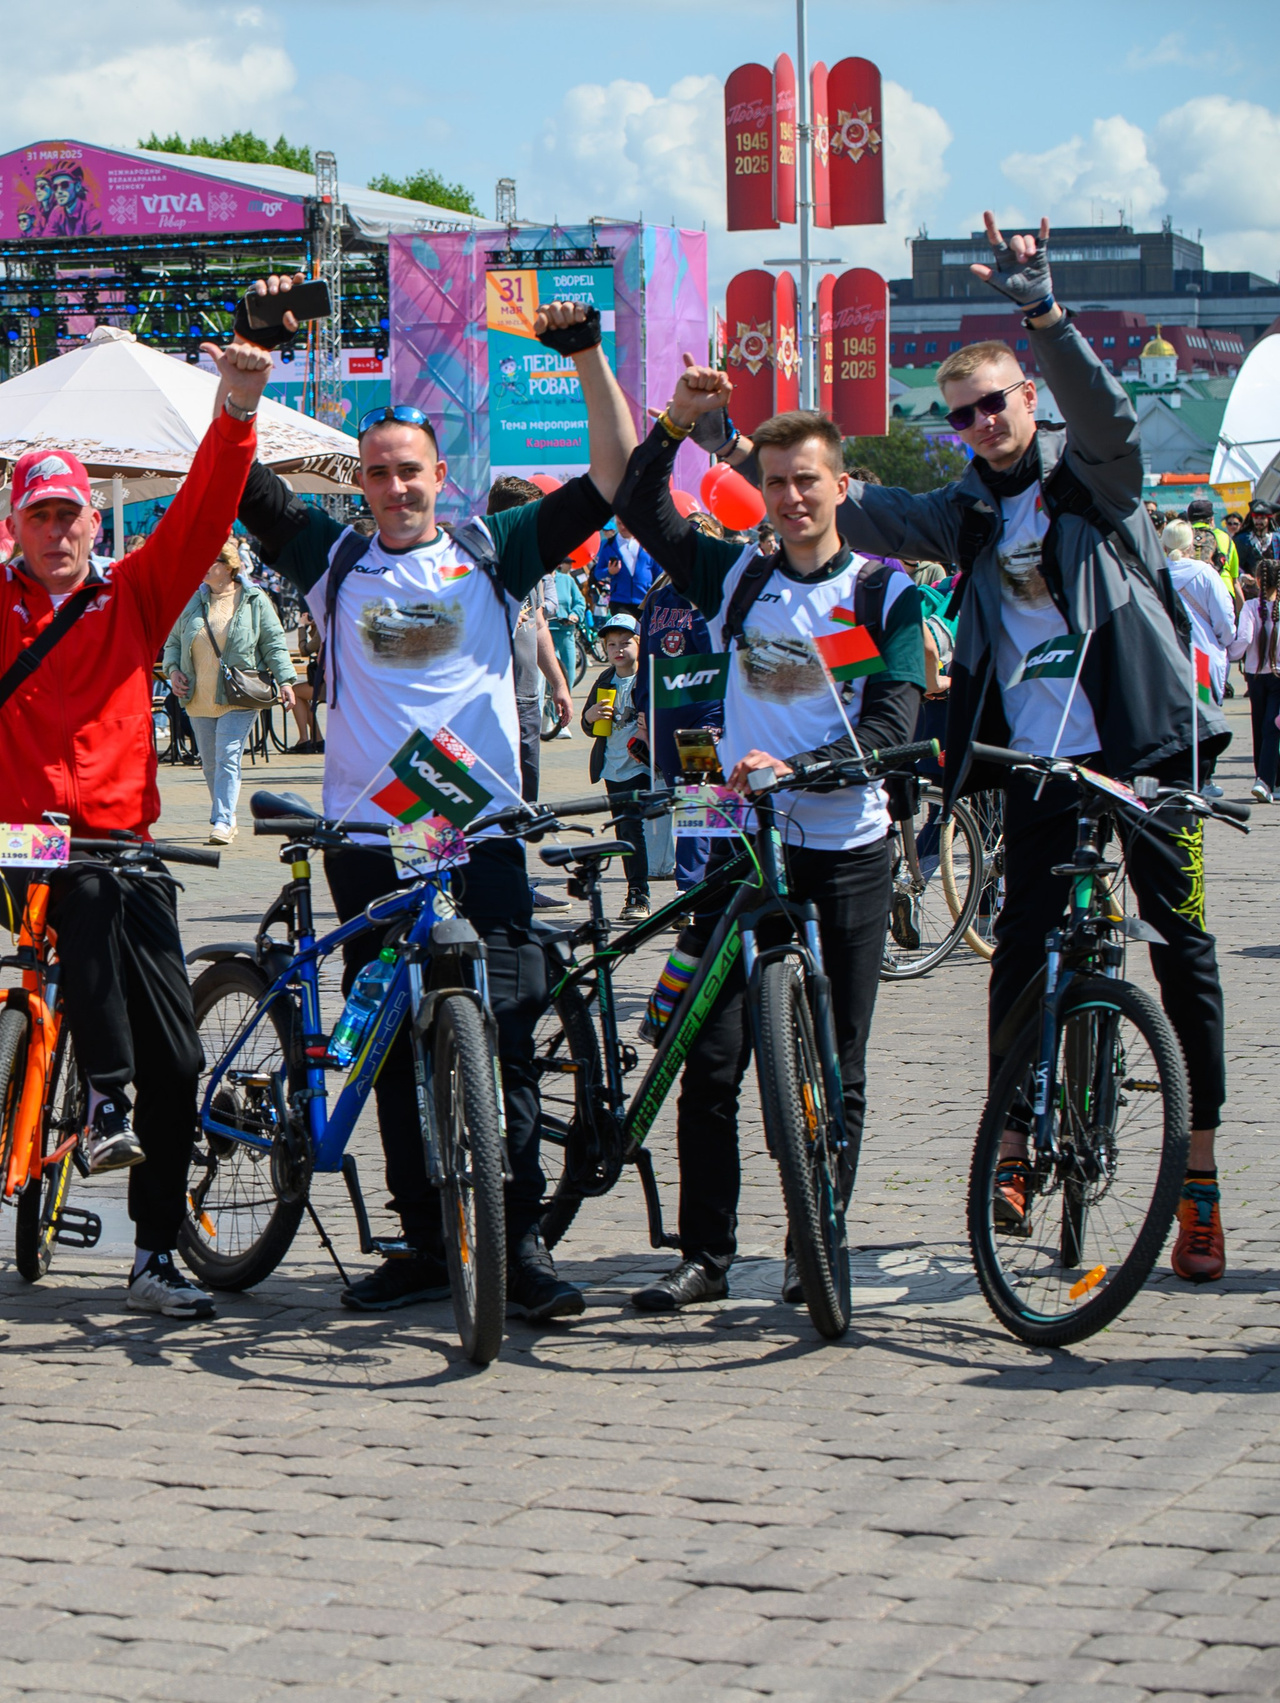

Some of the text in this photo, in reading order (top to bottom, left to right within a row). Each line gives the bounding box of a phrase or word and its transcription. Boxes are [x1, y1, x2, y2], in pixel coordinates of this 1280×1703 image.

[736, 132, 768, 152] 1945
[40, 151, 58, 159] МАЯ
[60, 150, 83, 159] 2025
[735, 155, 769, 175] 2025
[141, 193, 205, 214] VIVA
[500, 277, 524, 302] 31
[553, 275, 595, 287] ДВОРЕЦ
[501, 306, 523, 315] мая
[843, 338, 876, 356] 1945
[841, 361, 877, 379] 2025
[528, 377, 580, 395] РОВАР
[500, 420, 588, 432] Тема мероприят
[526, 437, 581, 449] Карнавал!
[355, 991, 409, 1098] AUTHOR
